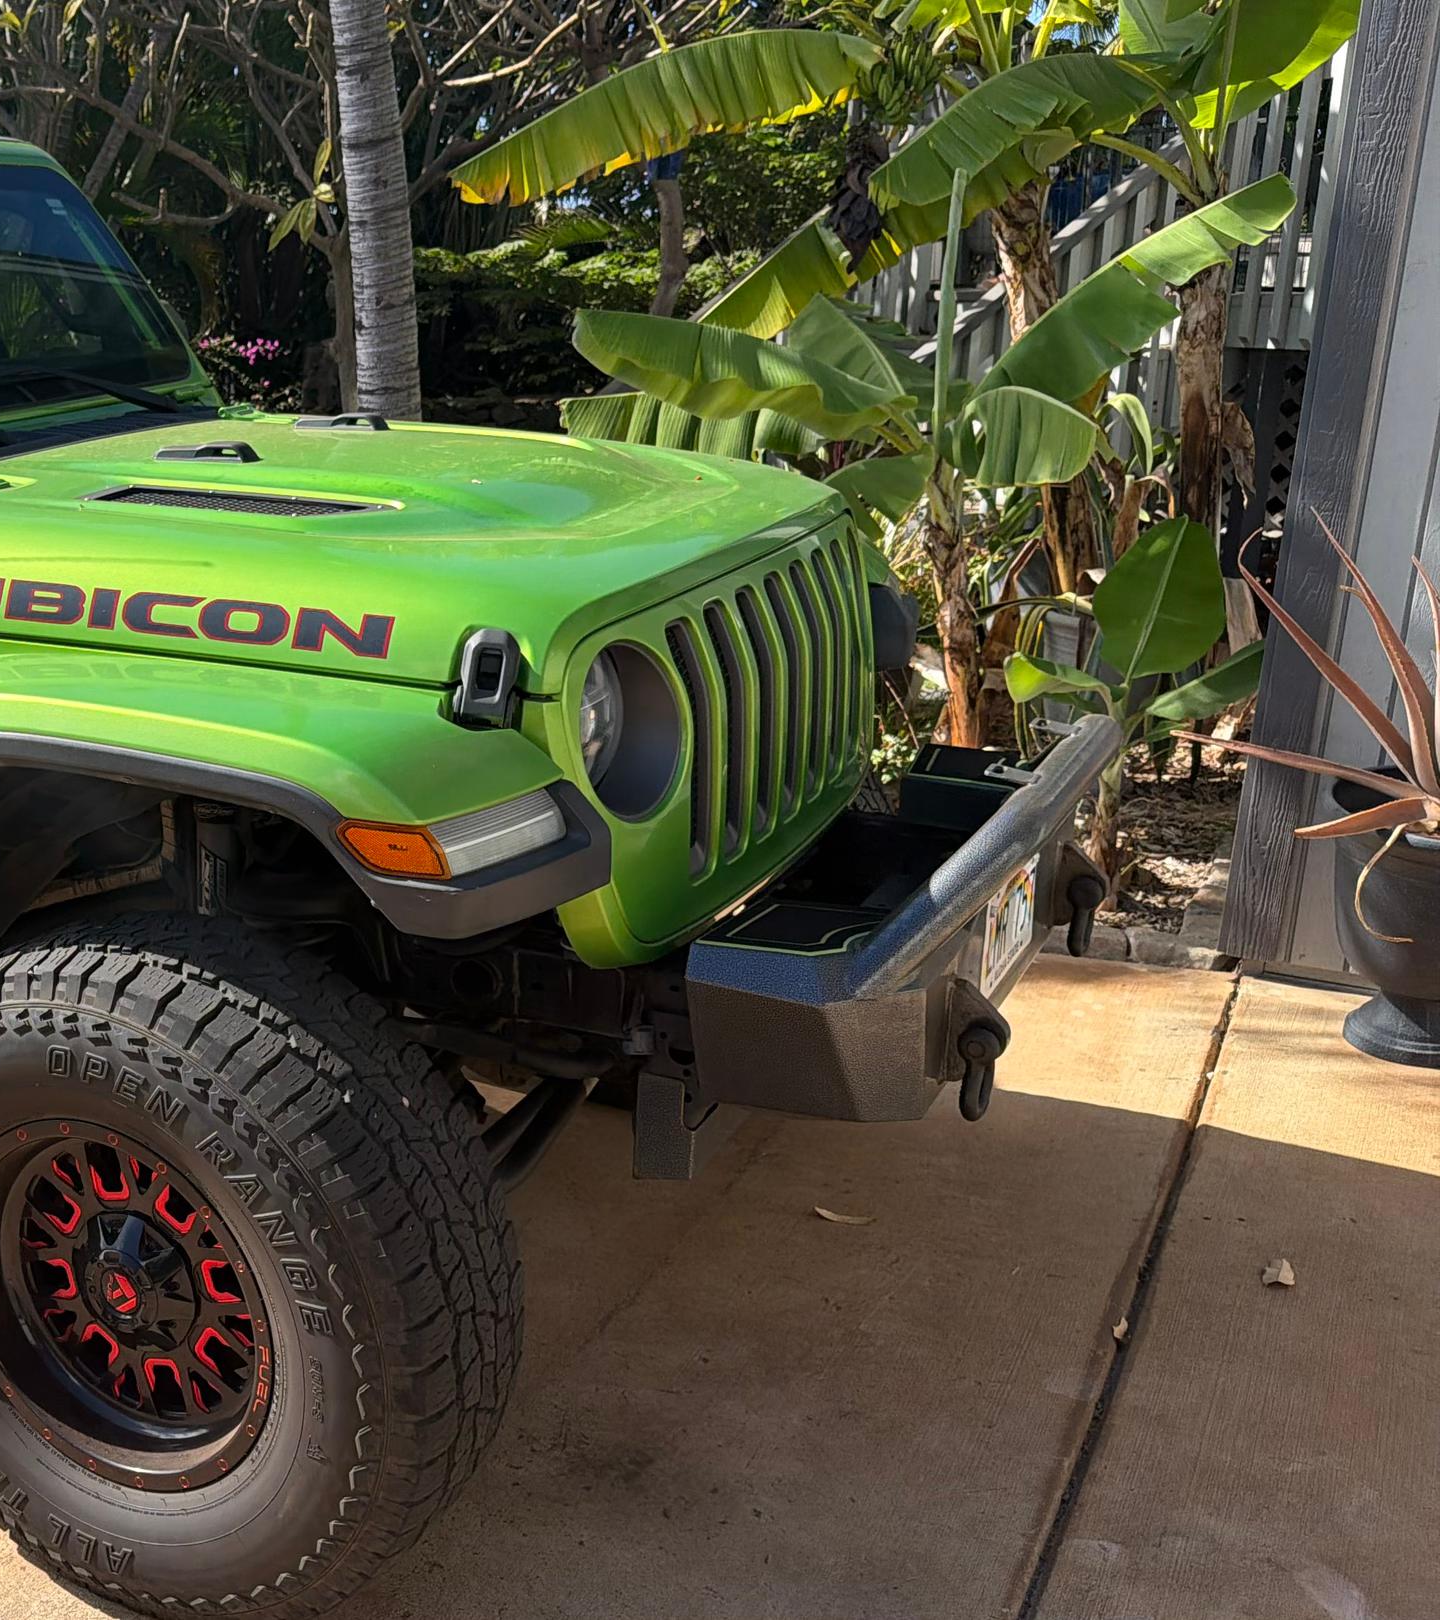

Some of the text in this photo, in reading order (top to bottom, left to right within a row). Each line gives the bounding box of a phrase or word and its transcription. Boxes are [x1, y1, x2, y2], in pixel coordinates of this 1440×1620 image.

[46, 1044, 334, 1336] OPEN RANGE
[253, 1346, 270, 1412] FUEL
[48, 1513, 133, 1576] ALL
